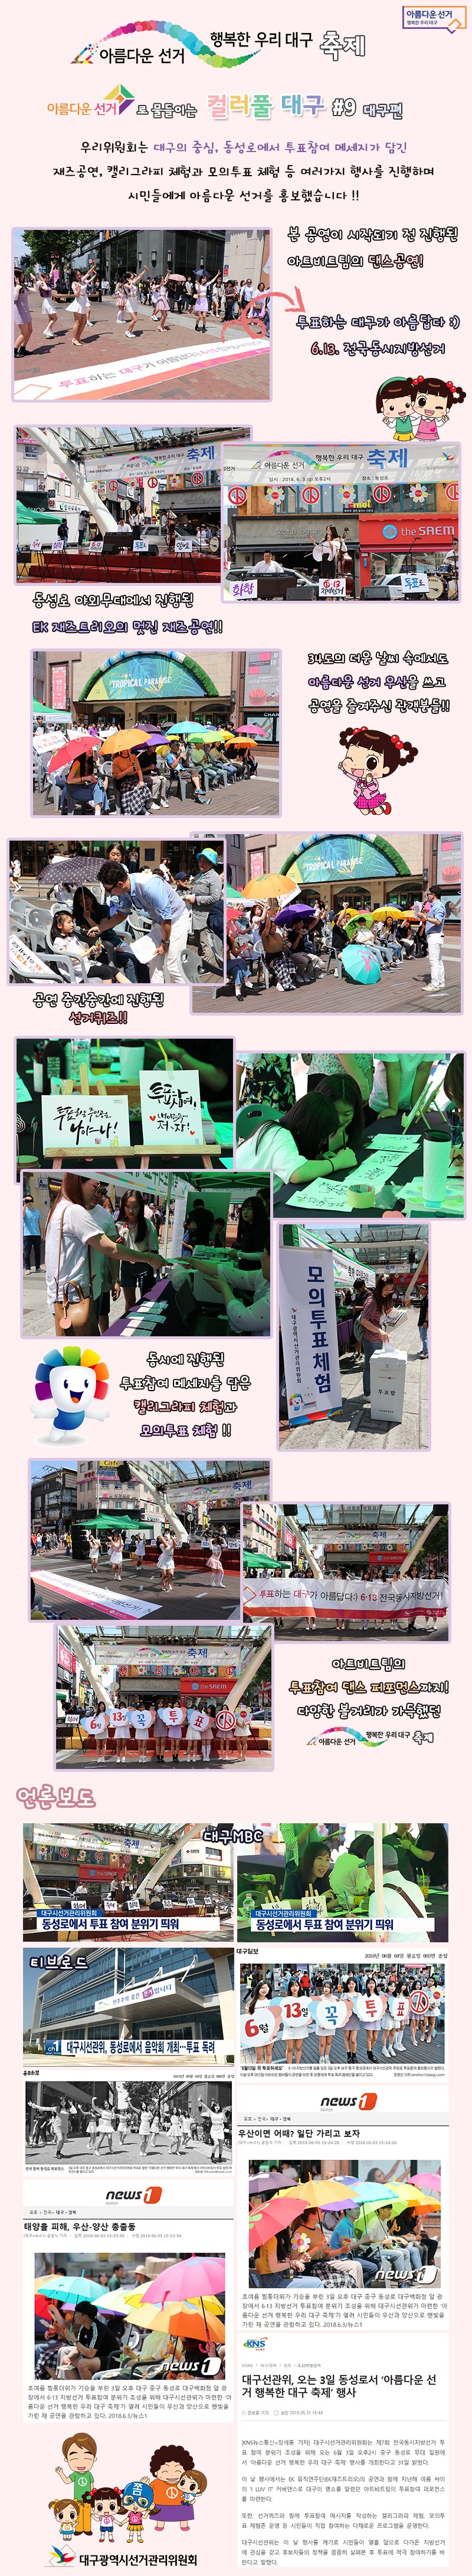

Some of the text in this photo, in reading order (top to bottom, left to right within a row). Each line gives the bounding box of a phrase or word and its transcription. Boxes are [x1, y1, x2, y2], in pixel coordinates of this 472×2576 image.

[58, 361, 156, 389] 투표하는 대구가
[154, 454, 166, 462] 행복한
[185, 445, 216, 463] 축제
[366, 448, 408, 470] 축제
[264, 461, 305, 470] 아름다운 선거
[48, 500, 55, 508] 약
[276, 528, 320, 537] Monologue
[401, 525, 454, 536] the SAEM
[232, 582, 254, 597] 화합
[405, 578, 425, 590] 투표로
[320, 587, 345, 595] 지방선거
[112, 676, 172, 689] TROPICAL PARADISE
[307, 1266, 332, 1394] 모의투표체험
[259, 1589, 443, 1603] 투표하는 대구가 아름답다:) 6·13 전국동시지방선거!
[187, 1648, 208, 1659] 축제
[112, 1712, 126, 1721] 13일
[136, 1715, 146, 1727] 꼭
[169, 1711, 178, 1722] 투
[194, 1715, 204, 1728] 표
[90, 1720, 101, 1730] 6월
[42, 1919, 179, 1930] 동성로에서 투표 참여 분위기 띄워
[113, 1996, 129, 2005] 민주주의
[67, 2041, 107, 2054] 대구시선관위,
[110, 2041, 142, 2054] 동성로에서
[145, 2041, 163, 2053] 음악회
[202, 2041, 214, 2053] 독려
[238, 2129, 360, 2138] 우산이면 어때? 일단 가리고 보자
[242, 2374, 435, 2386] 대구선관위, 오는 3일 동성로서 ‘아름다운 선
